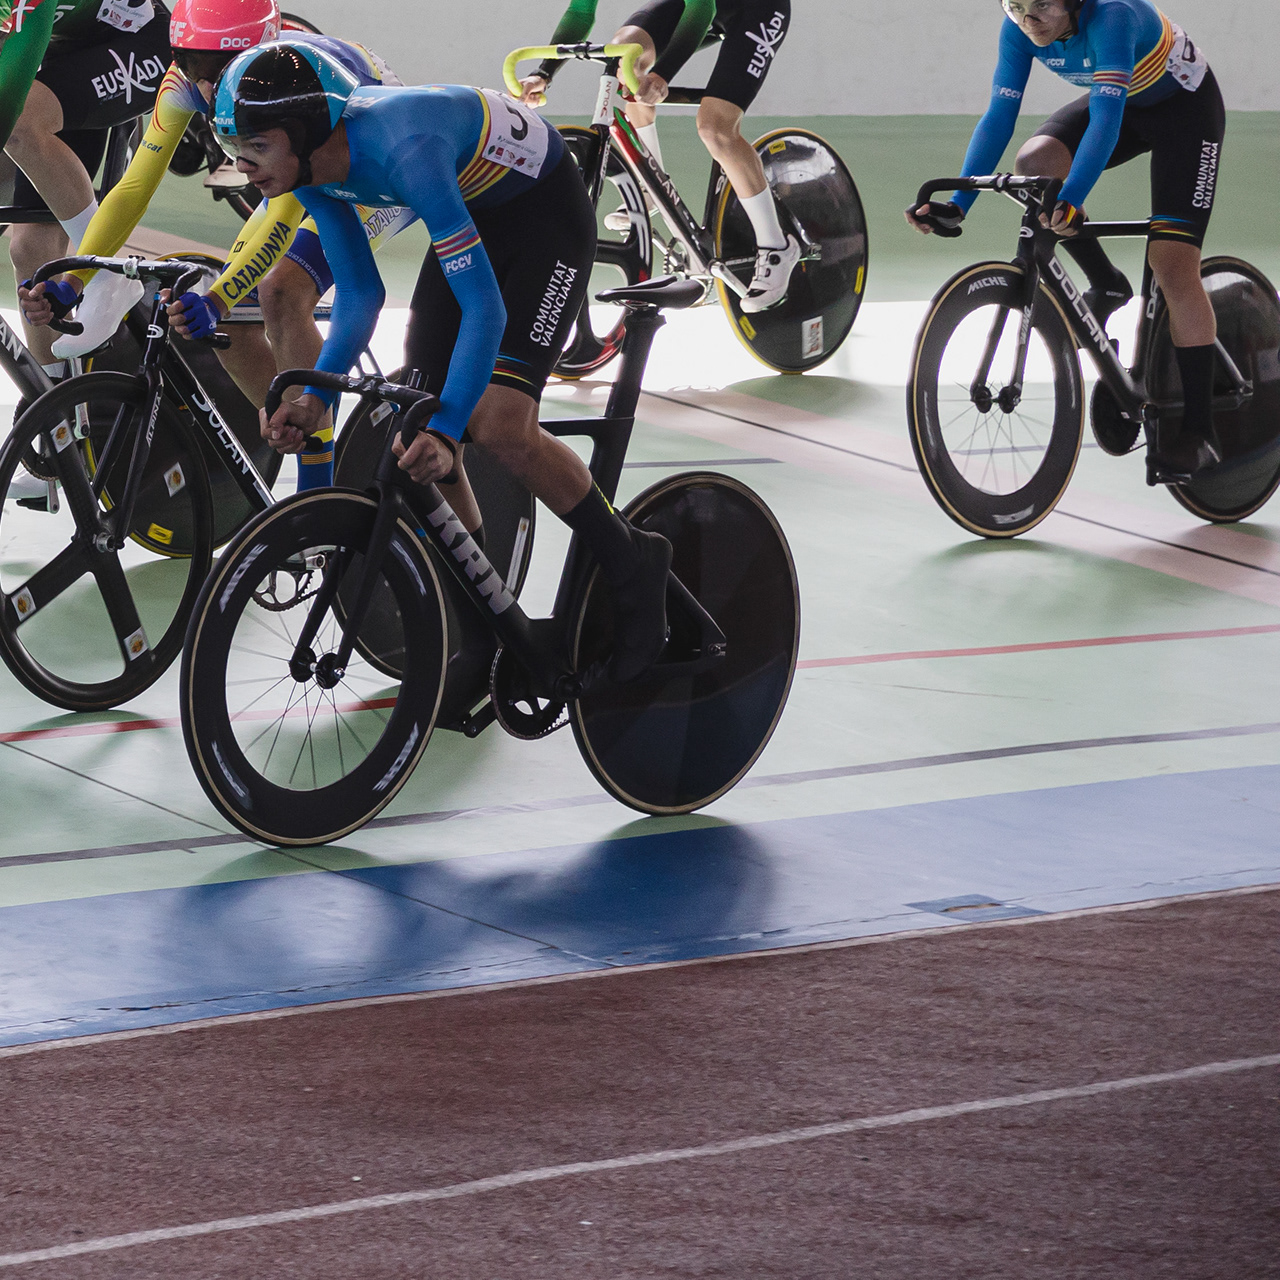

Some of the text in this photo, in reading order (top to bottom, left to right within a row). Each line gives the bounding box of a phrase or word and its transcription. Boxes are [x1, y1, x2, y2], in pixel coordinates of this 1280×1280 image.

[91, 48, 167, 105] EUSKADI
[746, 11, 786, 80] EUSKADI
[999, 86, 1022, 101] FCCV
[1099, 85, 1122, 98] FCCV
[1191, 138, 1213, 209] COMUNITAT
[1202, 141, 1219, 210] VALENCIANA
[222, 221, 292, 301] CATALUNYA
[445, 253, 473, 274] FCCV
[967, 275, 1009, 296] MICHE
[529, 259, 569, 345] COMUNITAT
[540, 267, 578, 348] VALENCIANA
[1048, 256, 1109, 354] DOLAN
[145, 390, 163, 448] ALPINA
